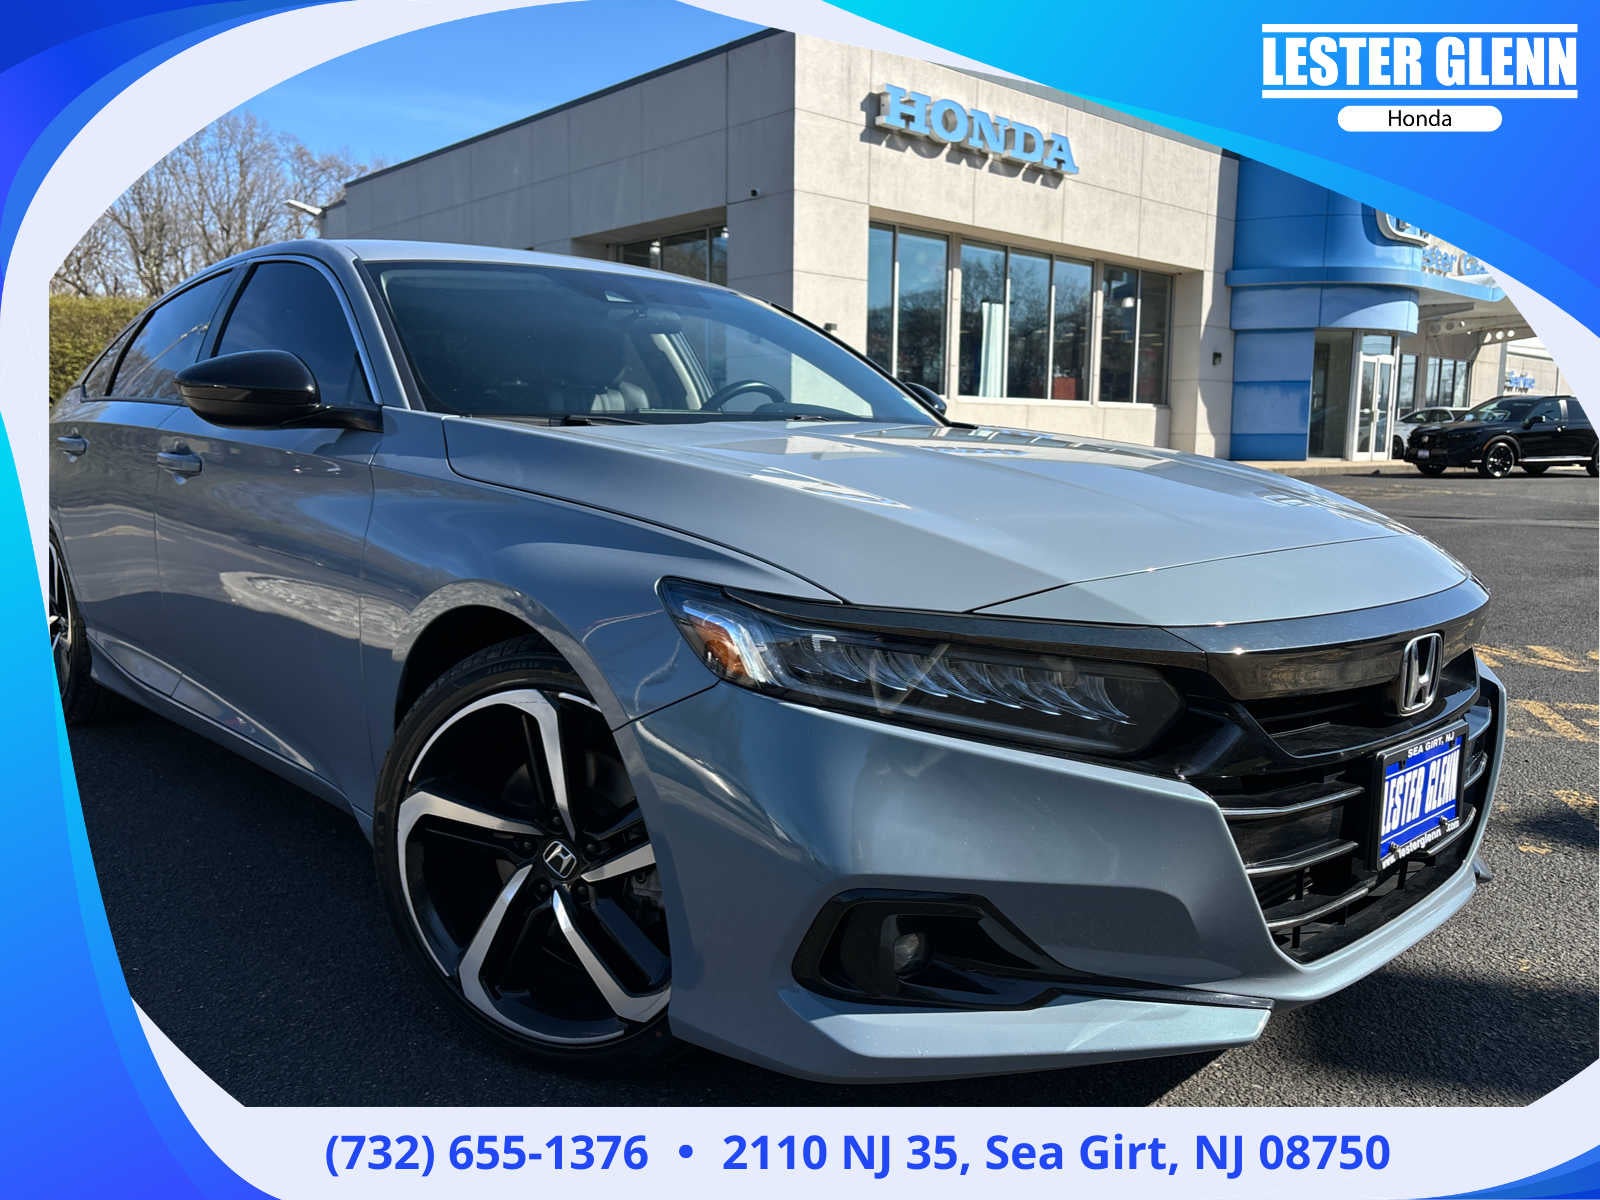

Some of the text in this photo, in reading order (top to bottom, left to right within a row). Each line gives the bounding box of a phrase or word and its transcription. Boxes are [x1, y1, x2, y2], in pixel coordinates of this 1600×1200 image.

[876, 83, 1079, 174] HONDA
[1407, 746, 1424, 758] SEA
[1445, 731, 1455, 741] NJ
[1382, 749, 1460, 836] LESTER GLENN
